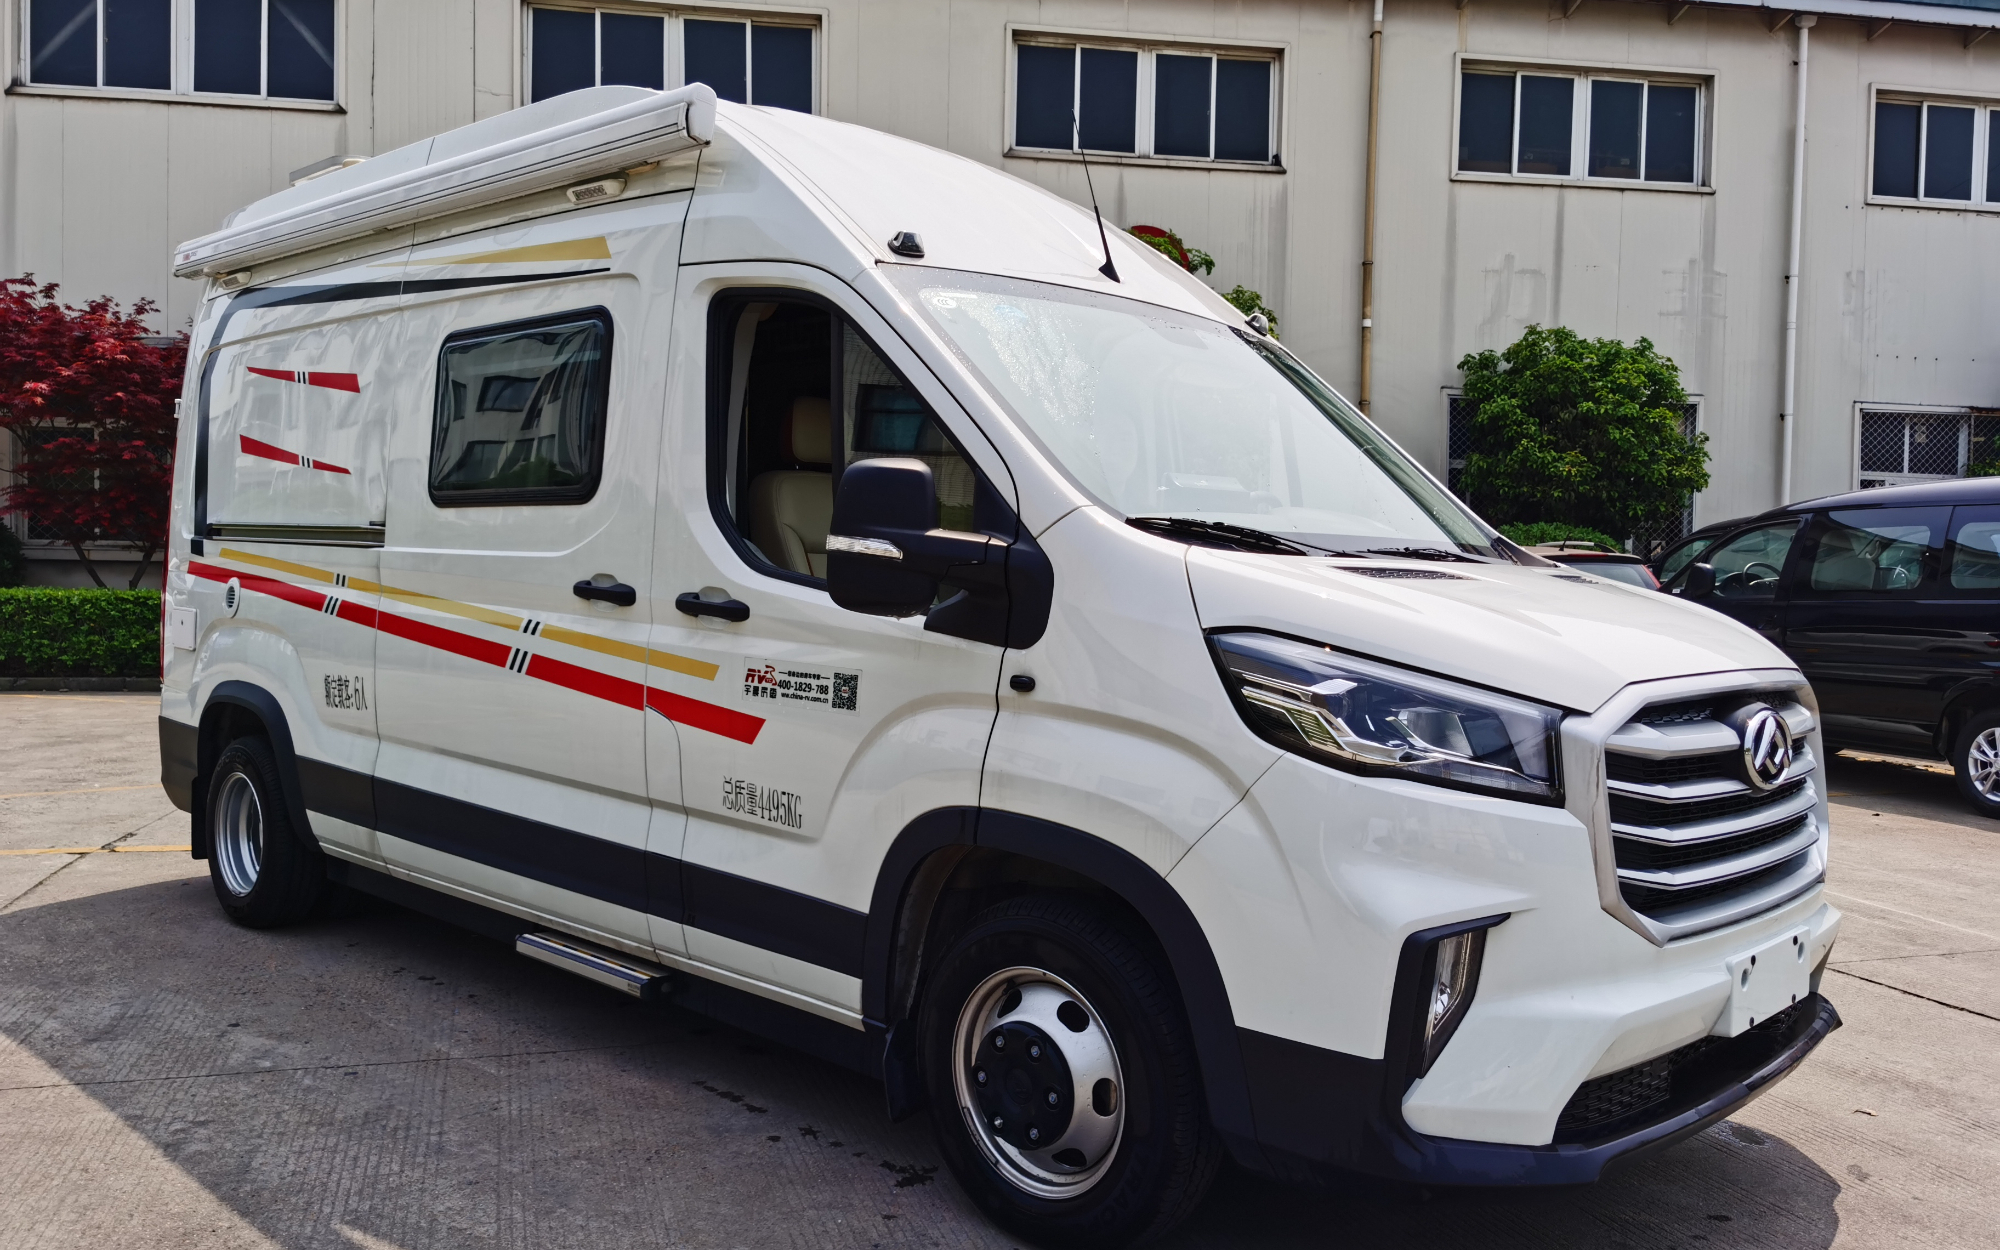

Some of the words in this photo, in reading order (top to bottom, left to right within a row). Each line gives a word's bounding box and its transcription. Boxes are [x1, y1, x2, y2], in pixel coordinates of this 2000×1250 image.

[777, 680, 829, 695] 400-1829-788
[723, 775, 802, 829] 总质量4495KG
